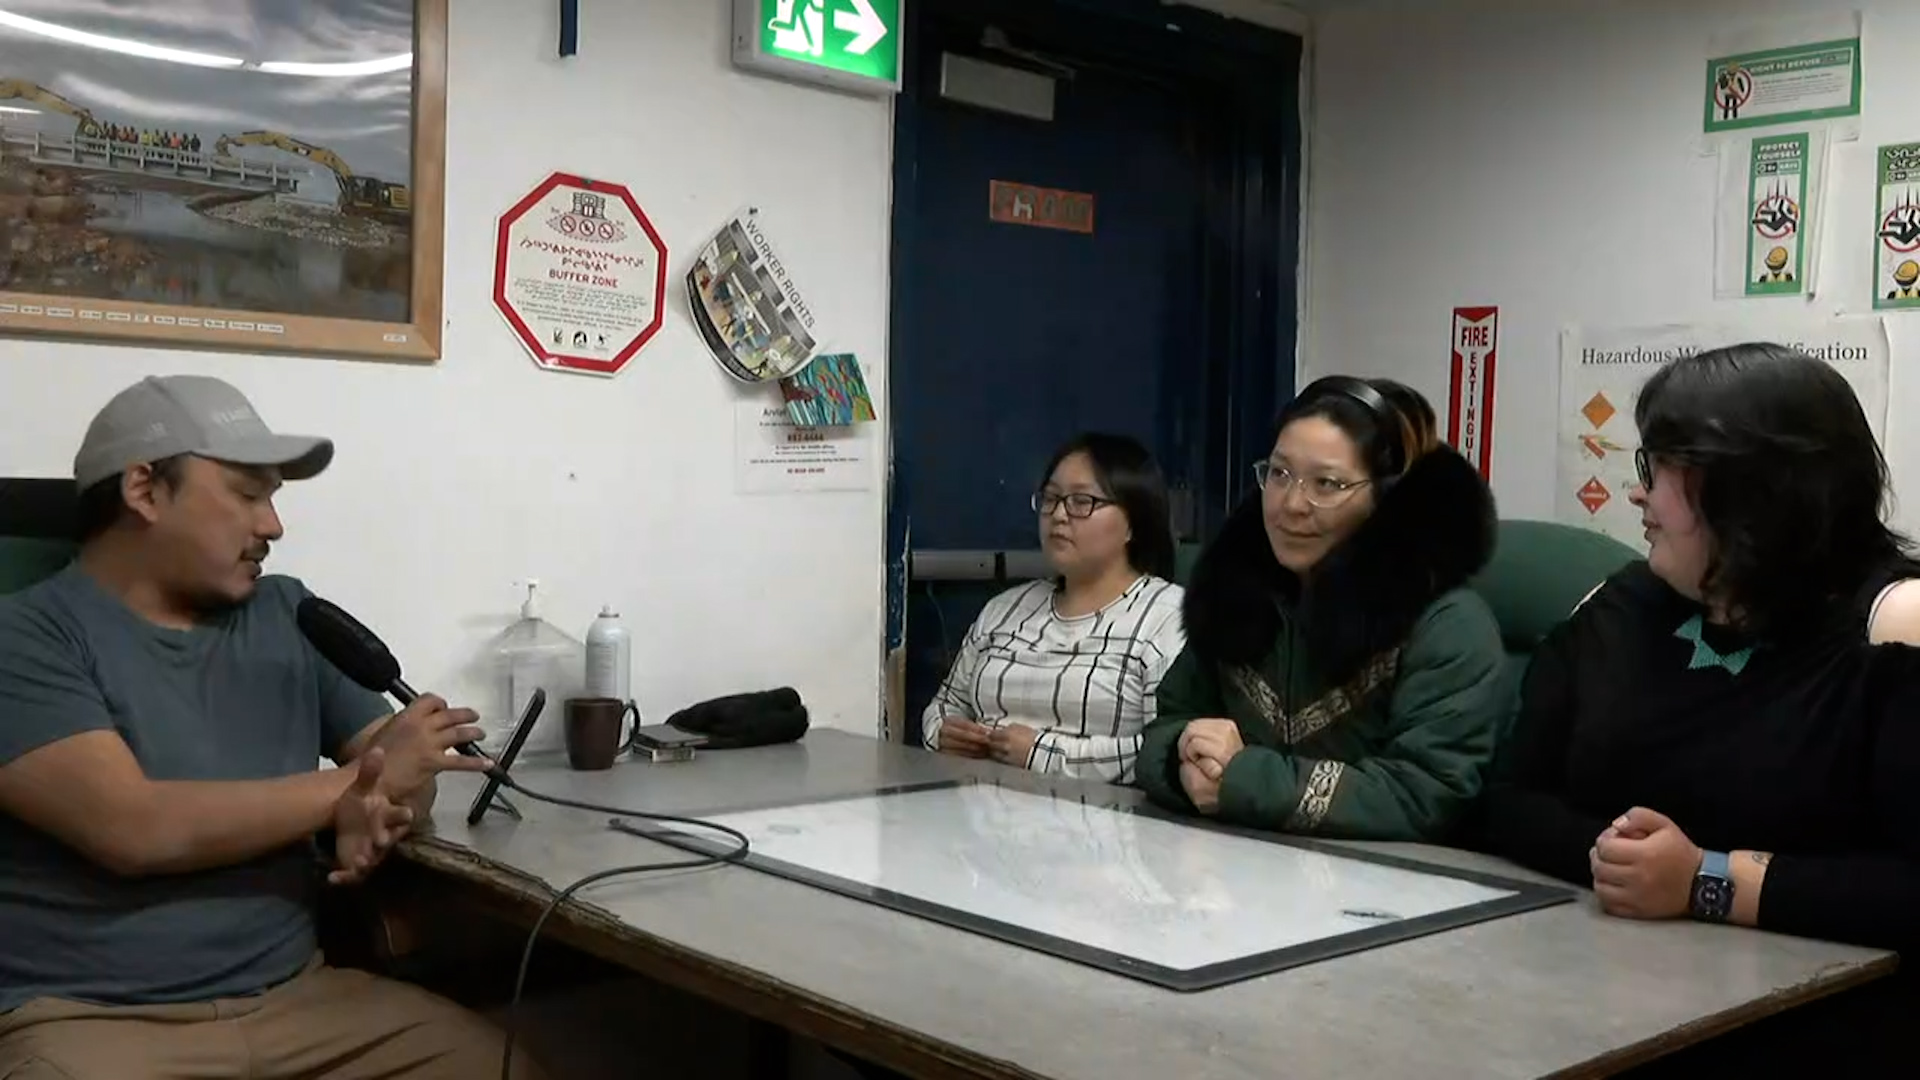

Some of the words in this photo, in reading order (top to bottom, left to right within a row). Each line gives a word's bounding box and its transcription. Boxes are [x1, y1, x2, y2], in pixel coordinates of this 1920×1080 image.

[1757, 150, 1801, 160] YOURSELF
[1759, 141, 1800, 152] PROTECT
[549, 269, 589, 283] BUFFER
[592, 272, 619, 288] ZONE
[746, 219, 786, 279] WORKER
[782, 279, 816, 329] RIGHTS
[1461, 326, 1489, 347] FIRE
[1581, 345, 1671, 365] Hazardous
[1465, 351, 1478, 463] EXTINGUI
